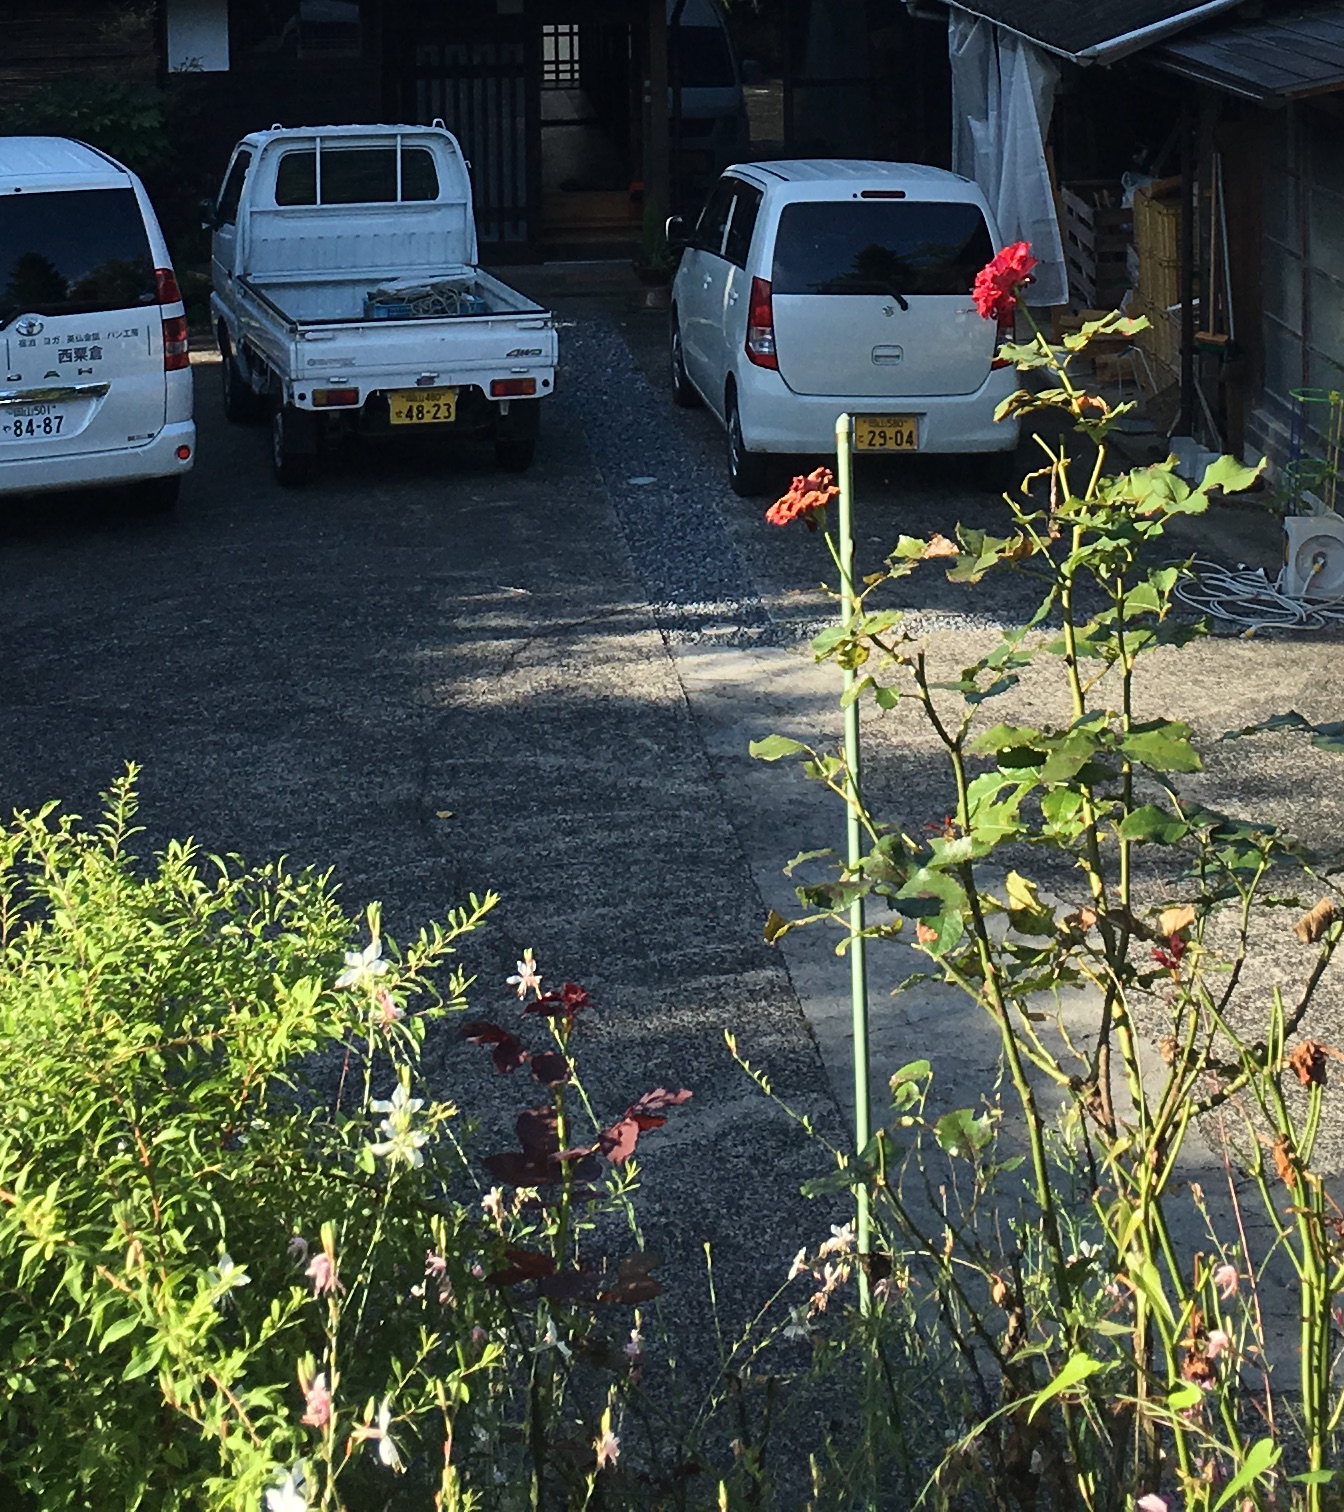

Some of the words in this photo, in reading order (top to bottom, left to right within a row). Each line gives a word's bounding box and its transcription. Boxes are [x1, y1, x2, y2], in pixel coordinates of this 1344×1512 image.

[506, 348, 543, 357] 4WD
[405, 402, 452, 421] 48-23
[13, 415, 64, 438] 84-87
[867, 429, 914, 447] 29-04
